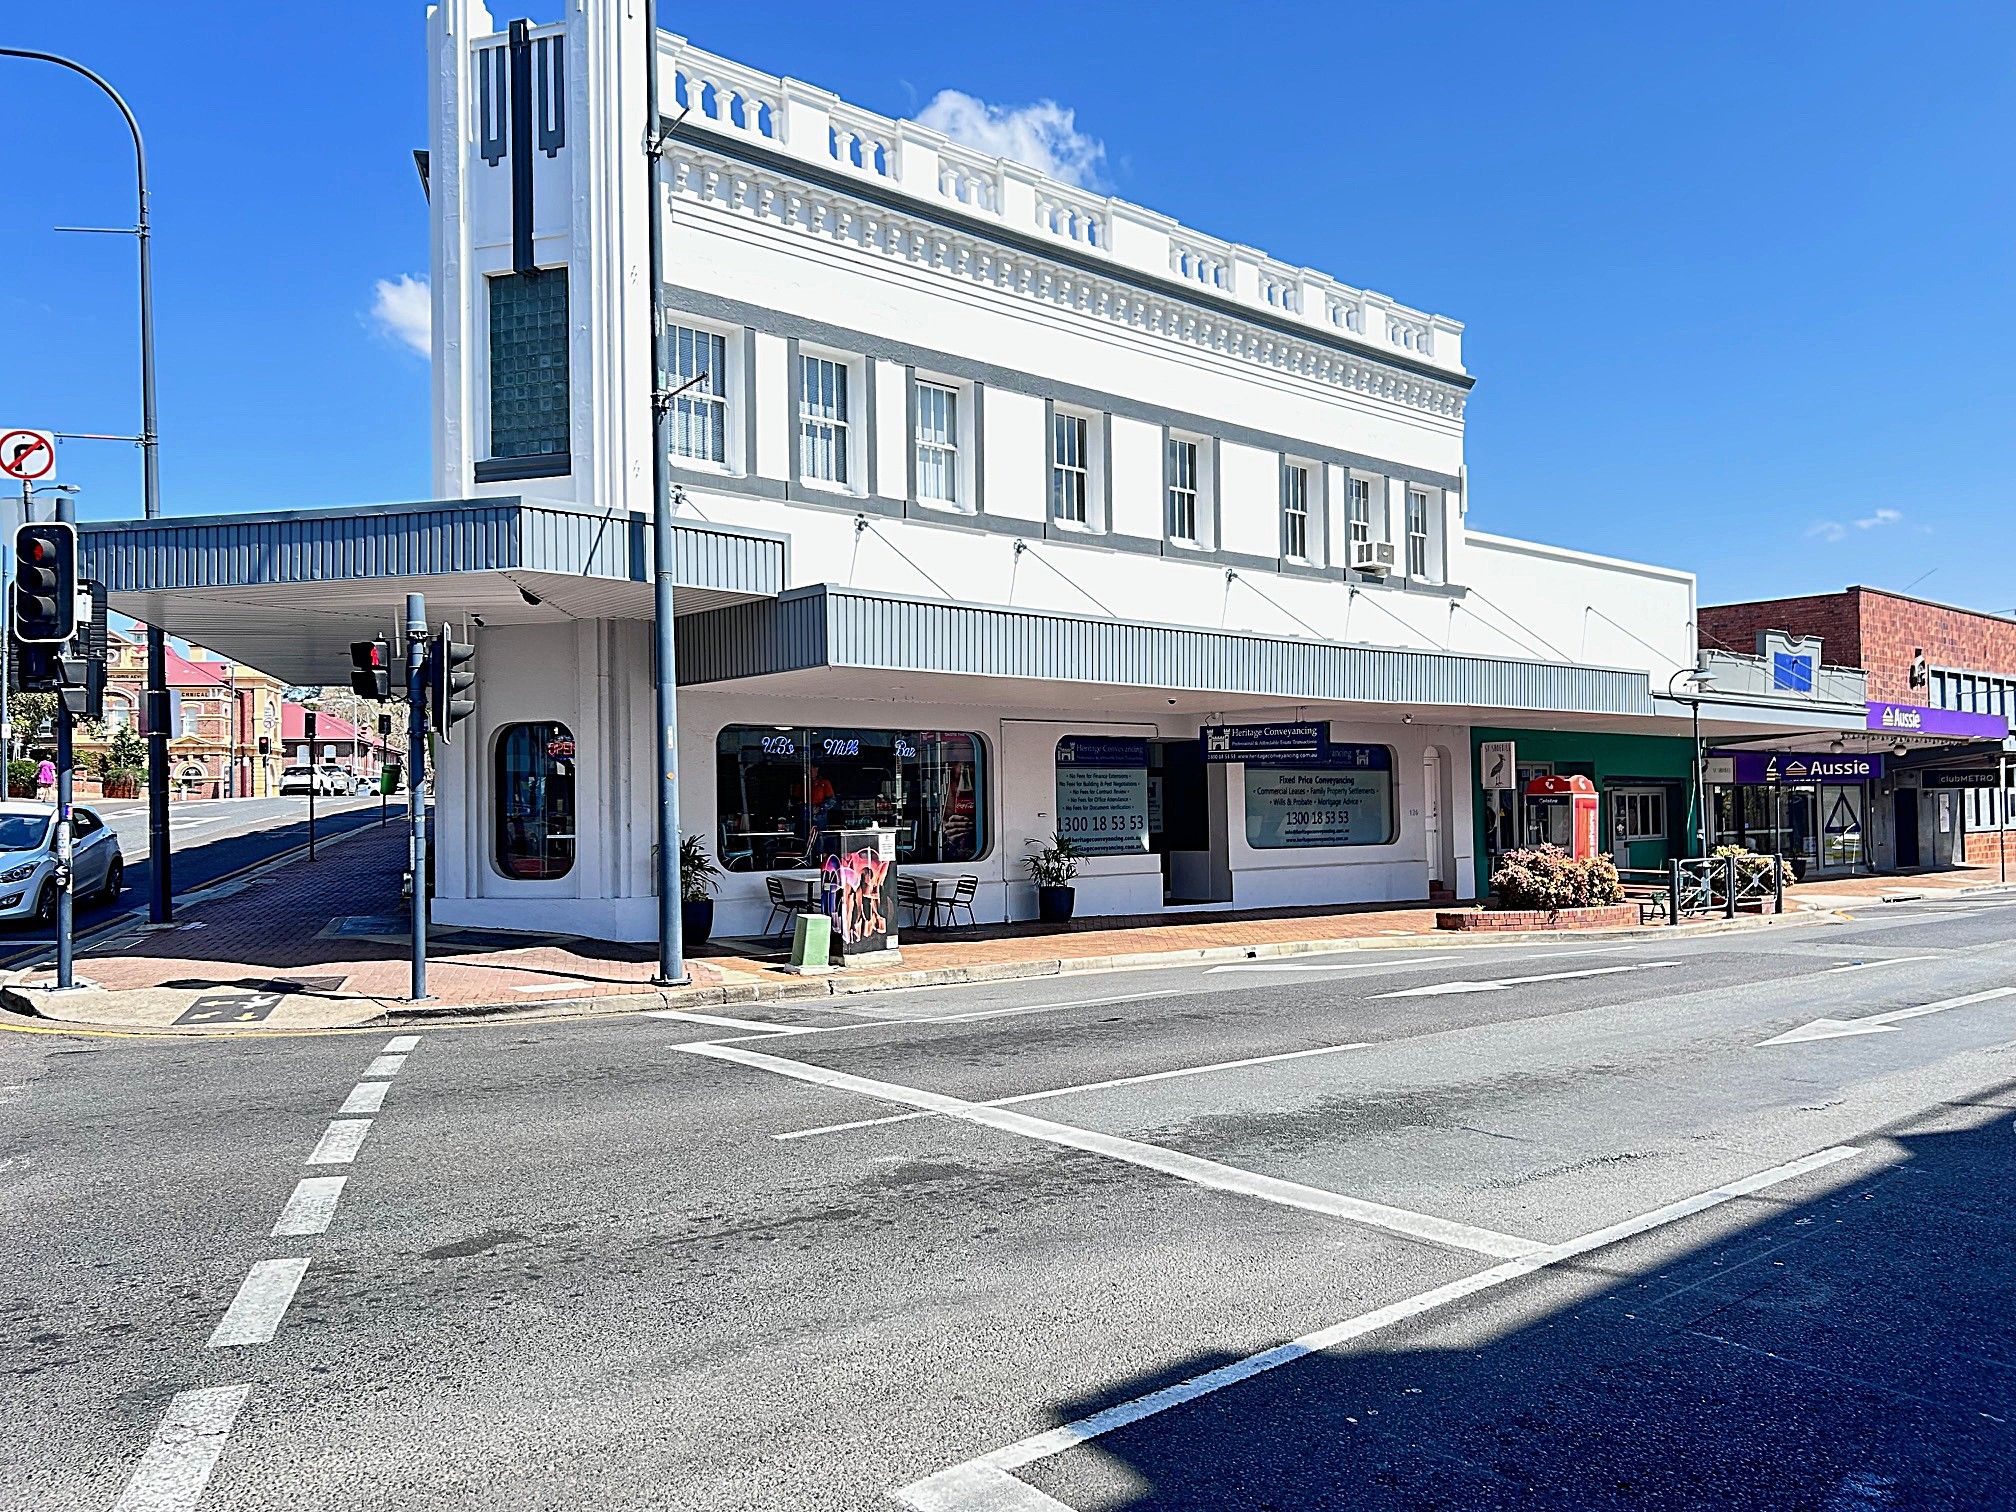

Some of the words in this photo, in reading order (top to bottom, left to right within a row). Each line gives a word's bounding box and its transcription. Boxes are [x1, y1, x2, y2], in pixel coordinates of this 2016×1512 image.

[1894, 708, 1920, 728] Aussie
[1232, 728, 1262, 738] Heritage
[1264, 726, 1317, 737] Conveyancing
[824, 739, 859, 755] Milk
[895, 740, 916, 757] Bar
[1076, 744, 1100, 753] Heritage
[1810, 760, 1869, 775] Aussie
[1280, 776, 1296, 784] Fixed
[1298, 776, 1312, 784] Price
[1315, 776, 1354, 786] Conveyancing
[1310, 787, 1326, 796] Family
[1327, 788, 1347, 796] Property
[1318, 798, 1341, 807] Mortgage
[1058, 816, 1088, 832] 1300
[1093, 816, 1107, 831] 18
[1111, 816, 1125, 830] 53
[1130, 815, 1144, 830] 53
[1287, 812, 1309, 825] 1300
[1312, 811, 1322, 824] 18
[1325, 811, 1335, 824] 53
[1338, 811, 1349, 824] 53
